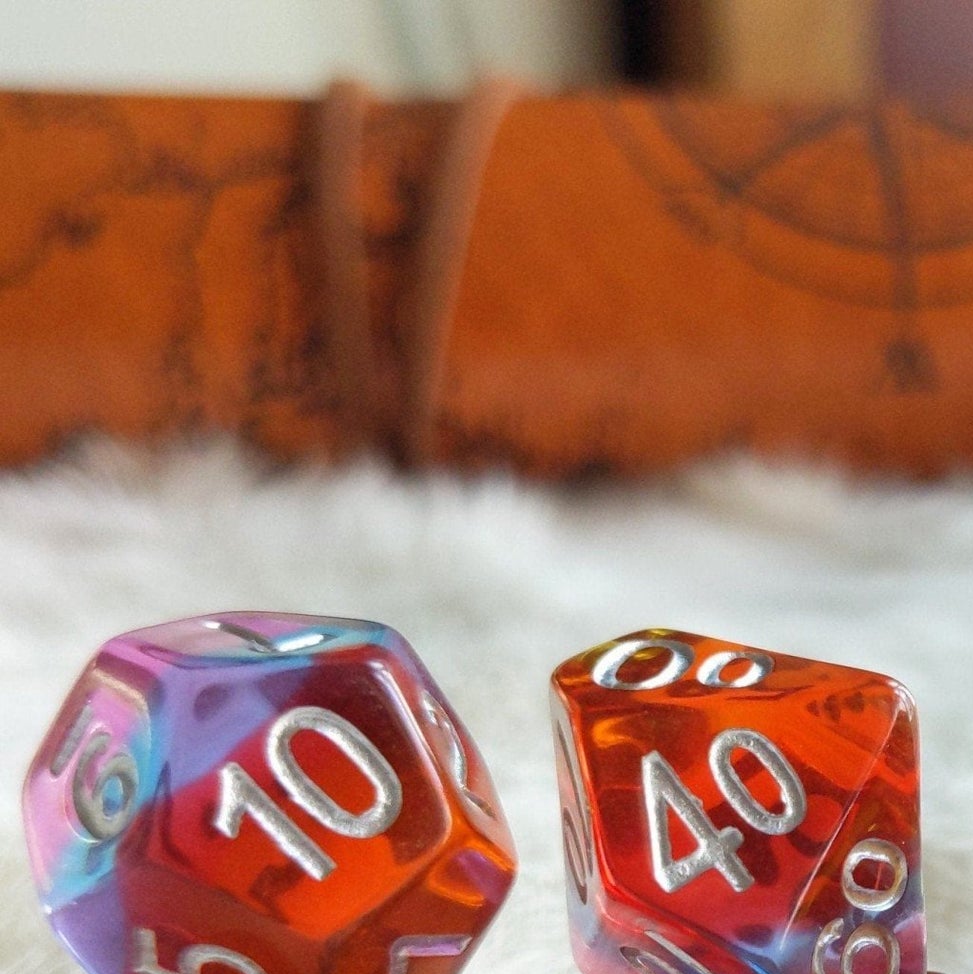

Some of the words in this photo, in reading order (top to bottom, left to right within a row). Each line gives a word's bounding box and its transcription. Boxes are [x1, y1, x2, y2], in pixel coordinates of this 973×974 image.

[591, 638, 775, 691] 00
[212, 705, 403, 882] 10
[640, 727, 807, 894] 40
